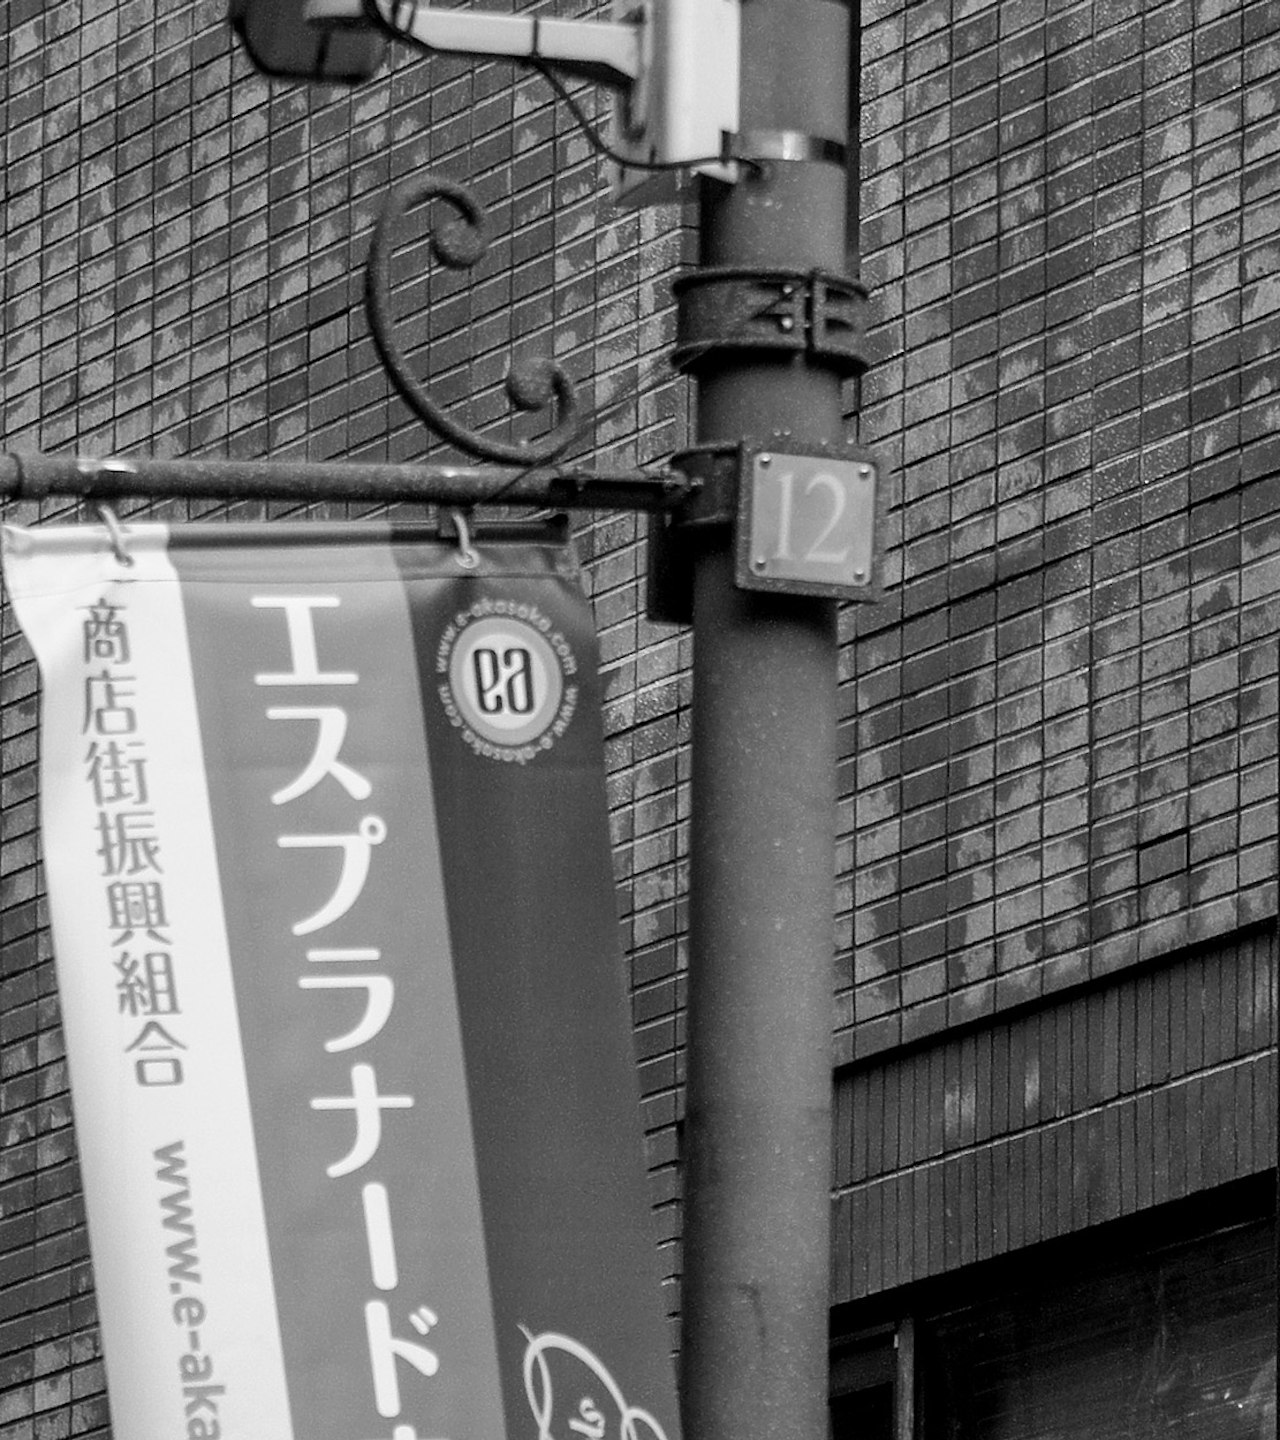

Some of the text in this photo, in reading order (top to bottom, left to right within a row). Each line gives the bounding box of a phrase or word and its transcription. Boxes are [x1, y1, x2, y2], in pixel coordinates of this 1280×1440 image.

[775, 470, 854, 564] 12
[81, 596, 189, 1088] 商店街振興組合
